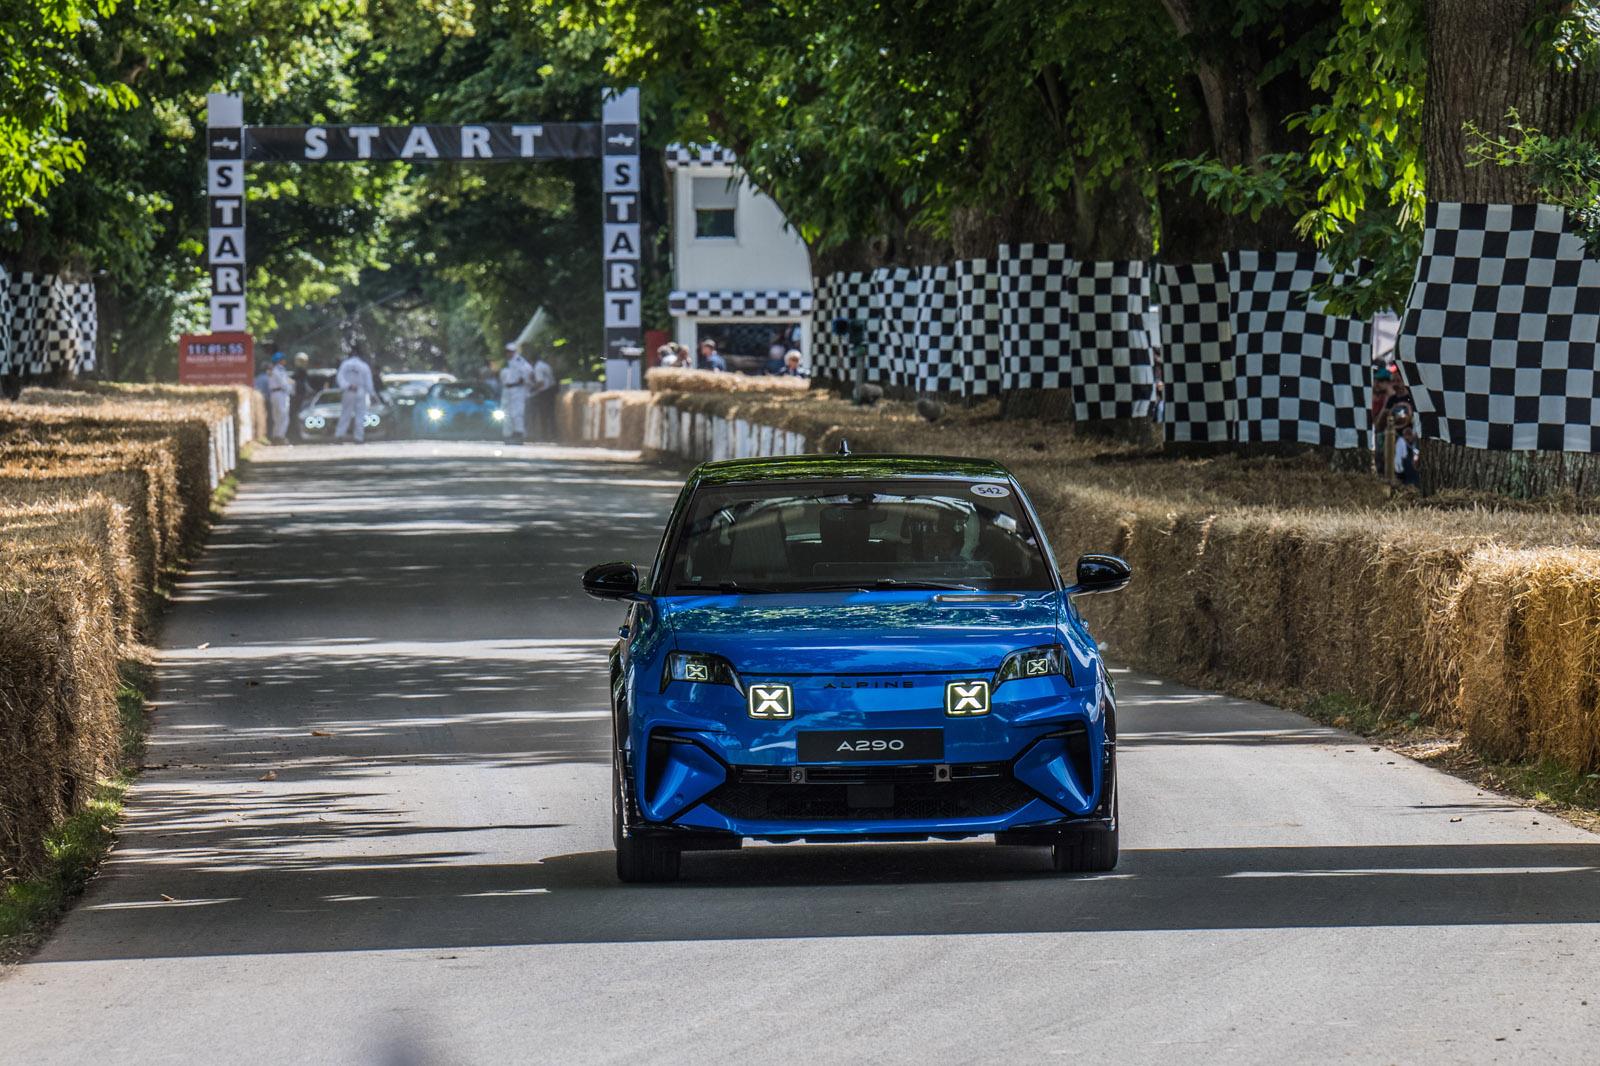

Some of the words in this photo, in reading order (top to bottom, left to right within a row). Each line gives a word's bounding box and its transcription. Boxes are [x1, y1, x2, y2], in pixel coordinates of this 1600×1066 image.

[304, 125, 544, 160] START
[214, 166, 242, 326] START
[611, 163, 637, 312] START
[977, 487, 1002, 495] 542
[823, 681, 914, 689] ALPINE
[836, 739, 904, 751] A290
